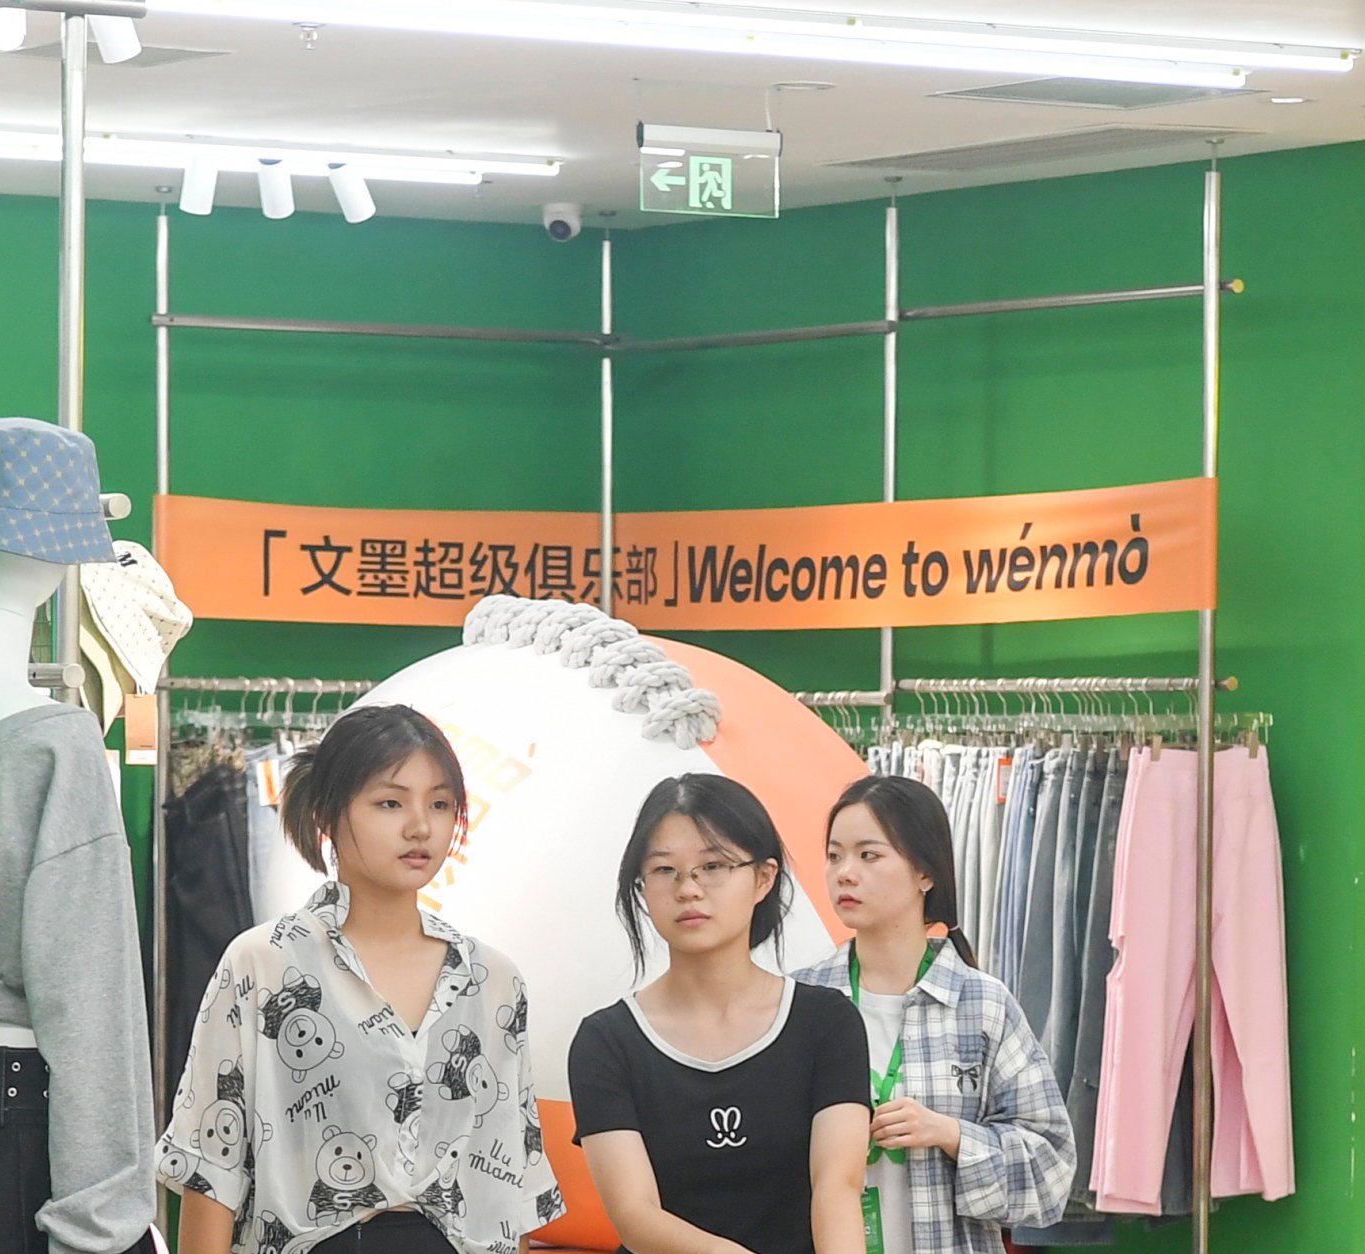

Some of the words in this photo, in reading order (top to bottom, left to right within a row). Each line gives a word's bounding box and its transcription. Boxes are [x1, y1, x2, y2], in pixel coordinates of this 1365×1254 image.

[688, 544, 887, 604] Welcome
[902, 541, 949, 598] to
[963, 513, 1149, 595] wénmò
[468, 1149, 524, 1190] miami
